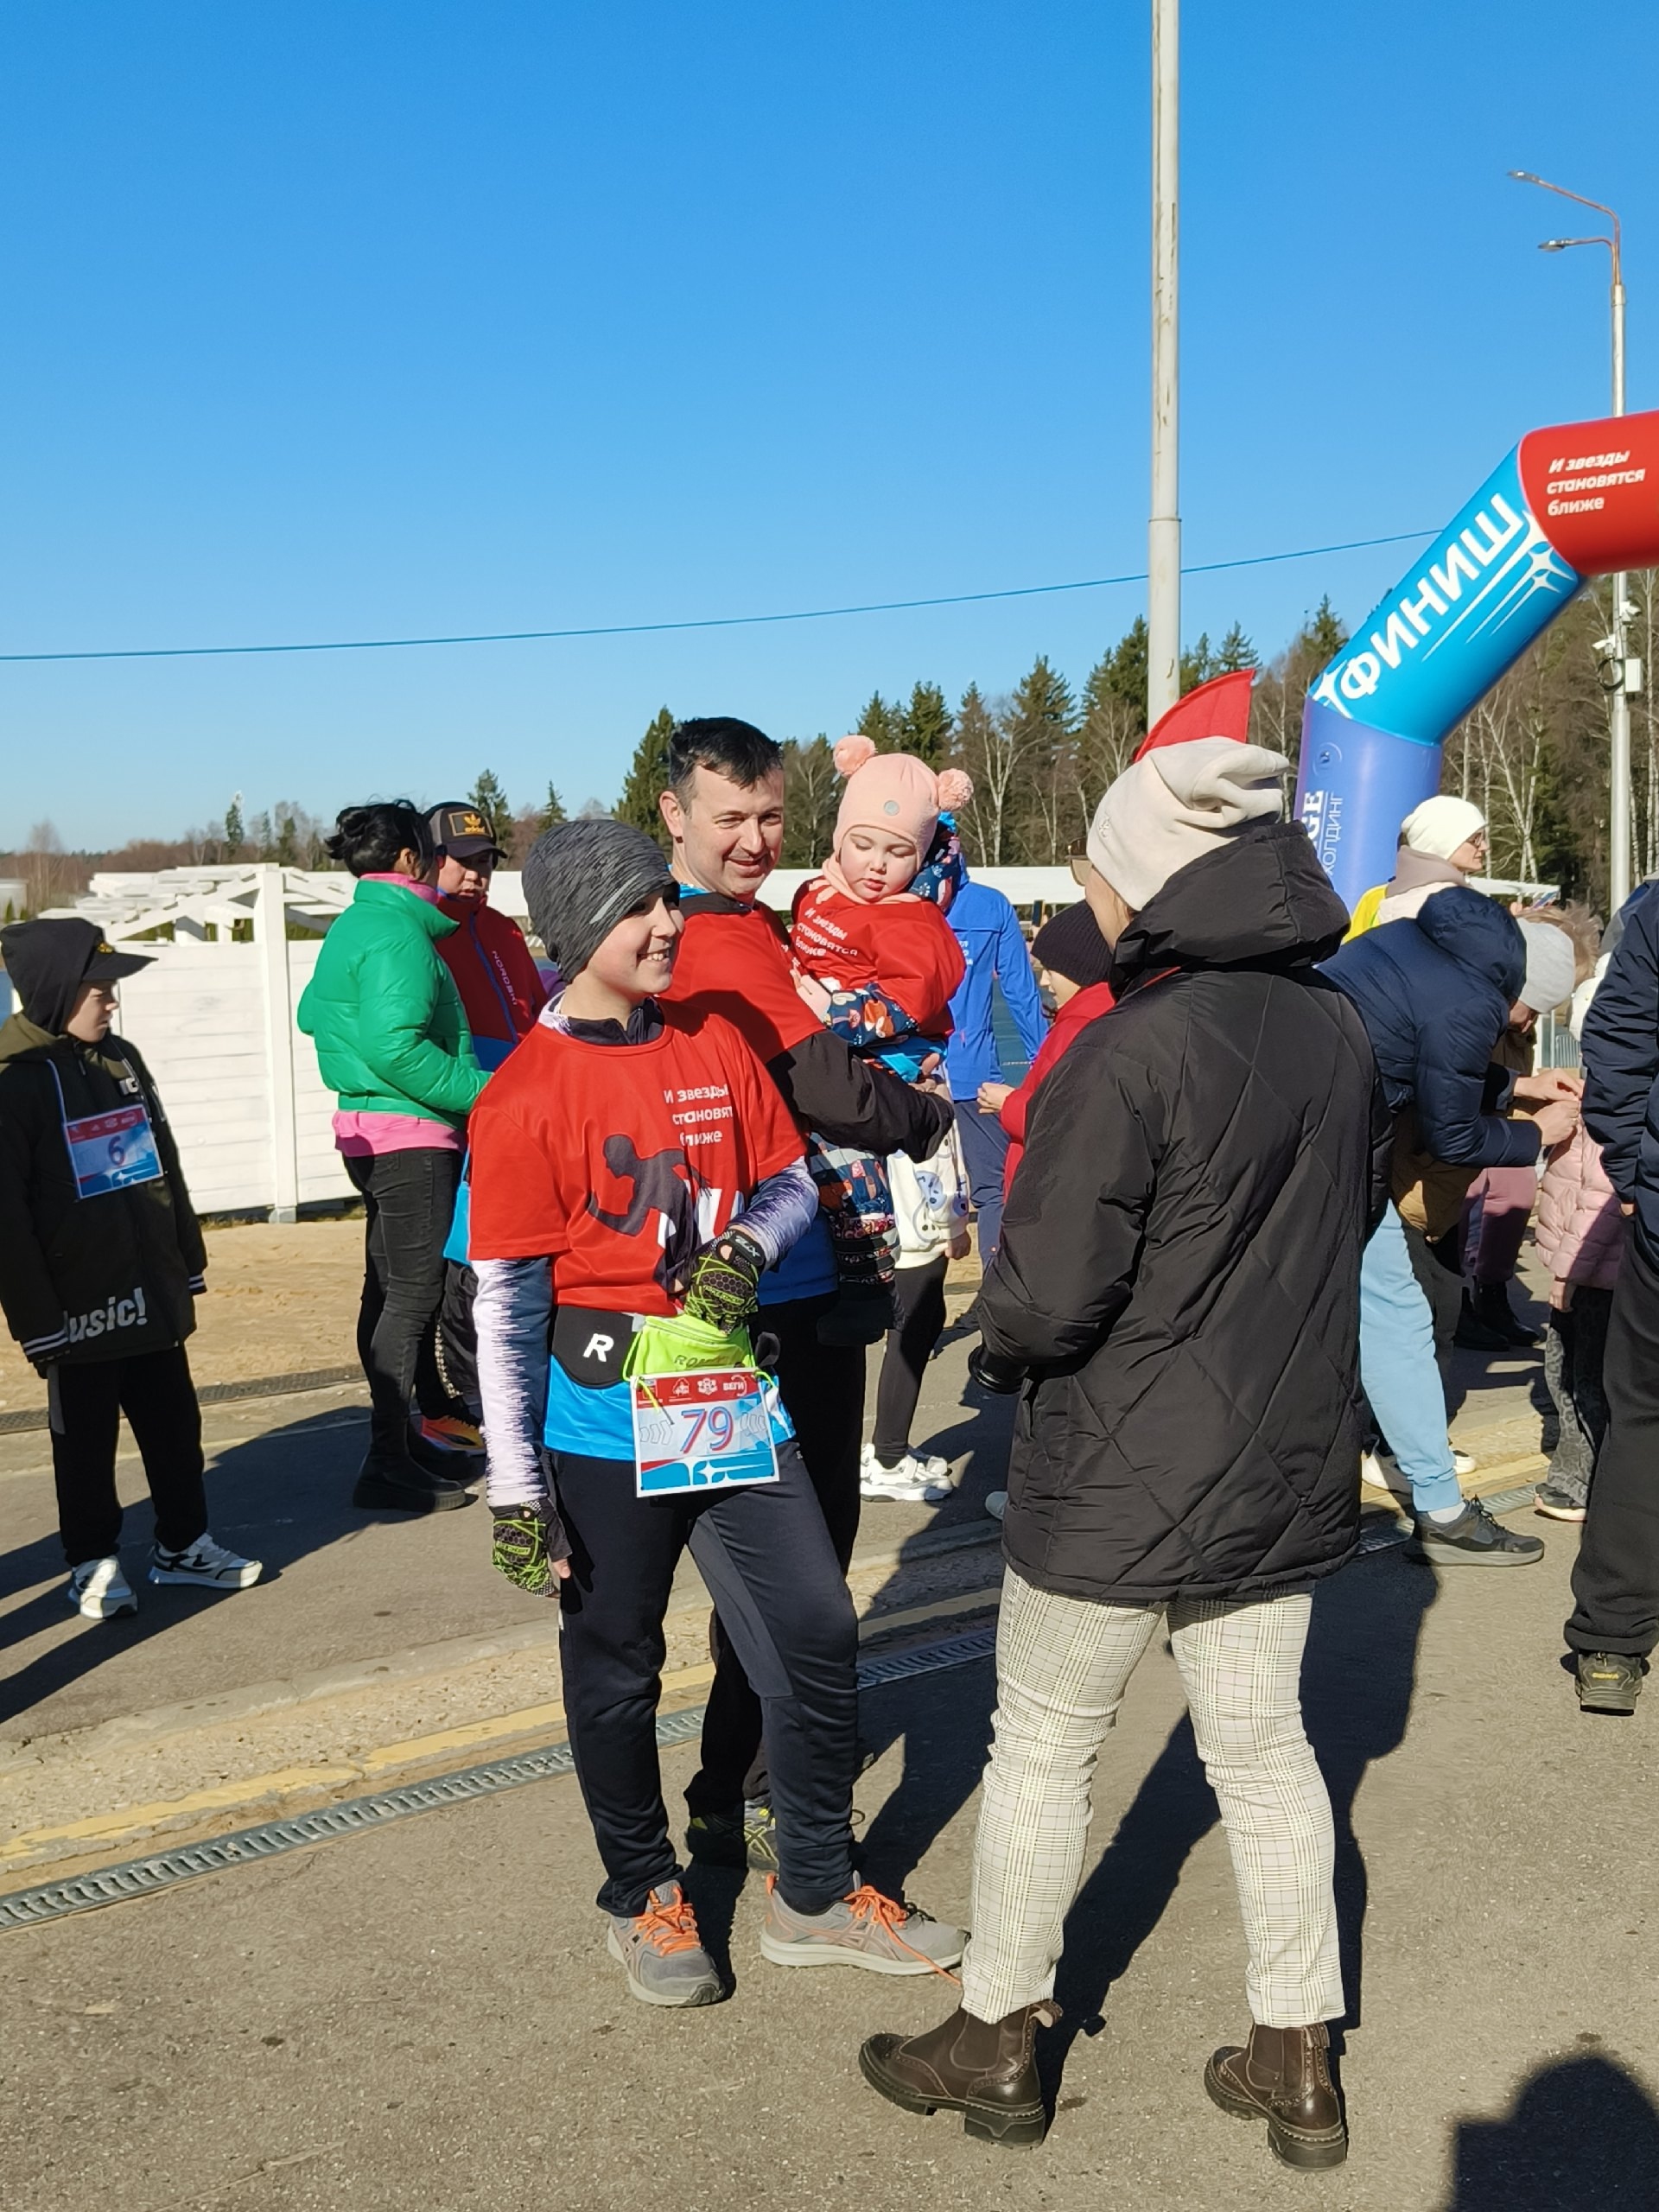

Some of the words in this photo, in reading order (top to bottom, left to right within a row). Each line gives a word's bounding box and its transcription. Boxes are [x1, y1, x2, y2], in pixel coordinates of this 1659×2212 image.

[1548, 457, 1566, 474] И
[1565, 449, 1630, 471] звезды
[1546, 467, 1646, 494] становятся
[1548, 497, 1605, 516] ближе
[1340, 493, 1524, 700] ФИНИШ
[1301, 790, 1325, 848] GE
[1322, 791, 1344, 876] ХОЛДИНГ
[663, 1089, 675, 1103] И
[677, 1084, 729, 1103] звезды
[672, 1106, 734, 1125] становят
[108, 1135, 125, 1167] 6
[64, 1287, 148, 1344] usic!
[582, 1333, 614, 1363] R
[680, 1406, 734, 1454] 79
